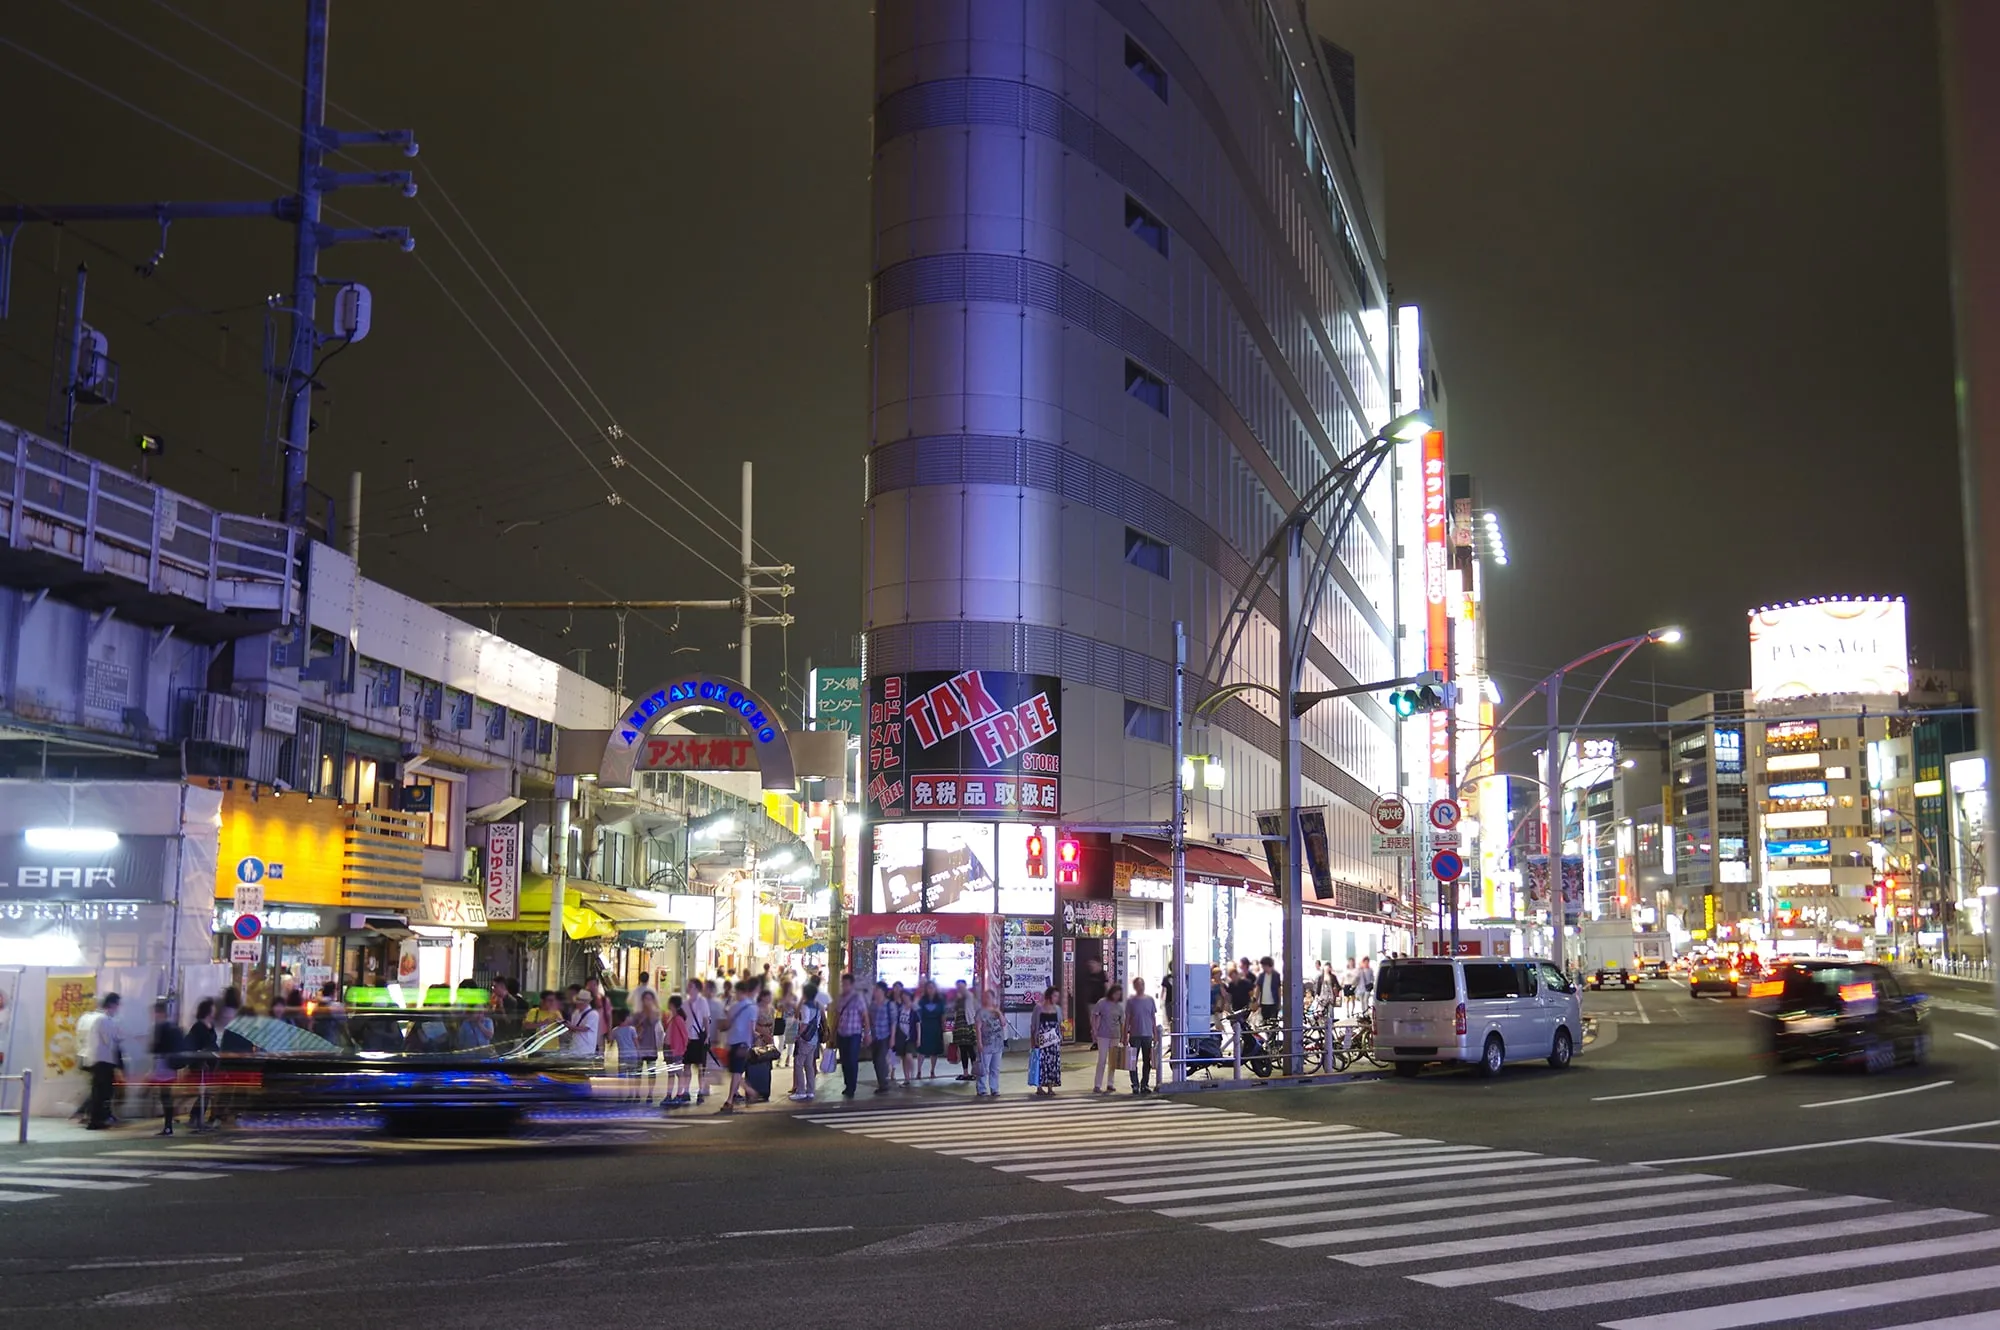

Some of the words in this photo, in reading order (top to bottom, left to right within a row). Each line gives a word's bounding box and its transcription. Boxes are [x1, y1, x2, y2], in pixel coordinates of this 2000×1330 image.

[1425, 459, 1443, 528] カラオケ
[817, 699, 862, 713] センター
[905, 669, 1002, 751] TAX
[824, 717, 852, 734] ビル
[869, 702, 883, 771] カメラ
[883, 676, 901, 770] ヨドバシ
[969, 691, 1058, 768] FREE
[646, 739, 754, 767] アメヤ横丁
[1022, 752, 1060, 773] STORE
[867, 772, 888, 803] TAX
[878, 780, 905, 811] FREE
[914, 781, 1056, 808] 免税品取扱店
[1378, 807, 1403, 820] 消火栓
[1379, 836, 1411, 850] 上野医院
[17, 865, 116, 889] BAR
[489, 838, 504, 905] じゅらく
[504, 868, 514, 905] レストラン
[429, 894, 466, 923] じゅらく
[895, 918, 938, 936] Coca-Cola
